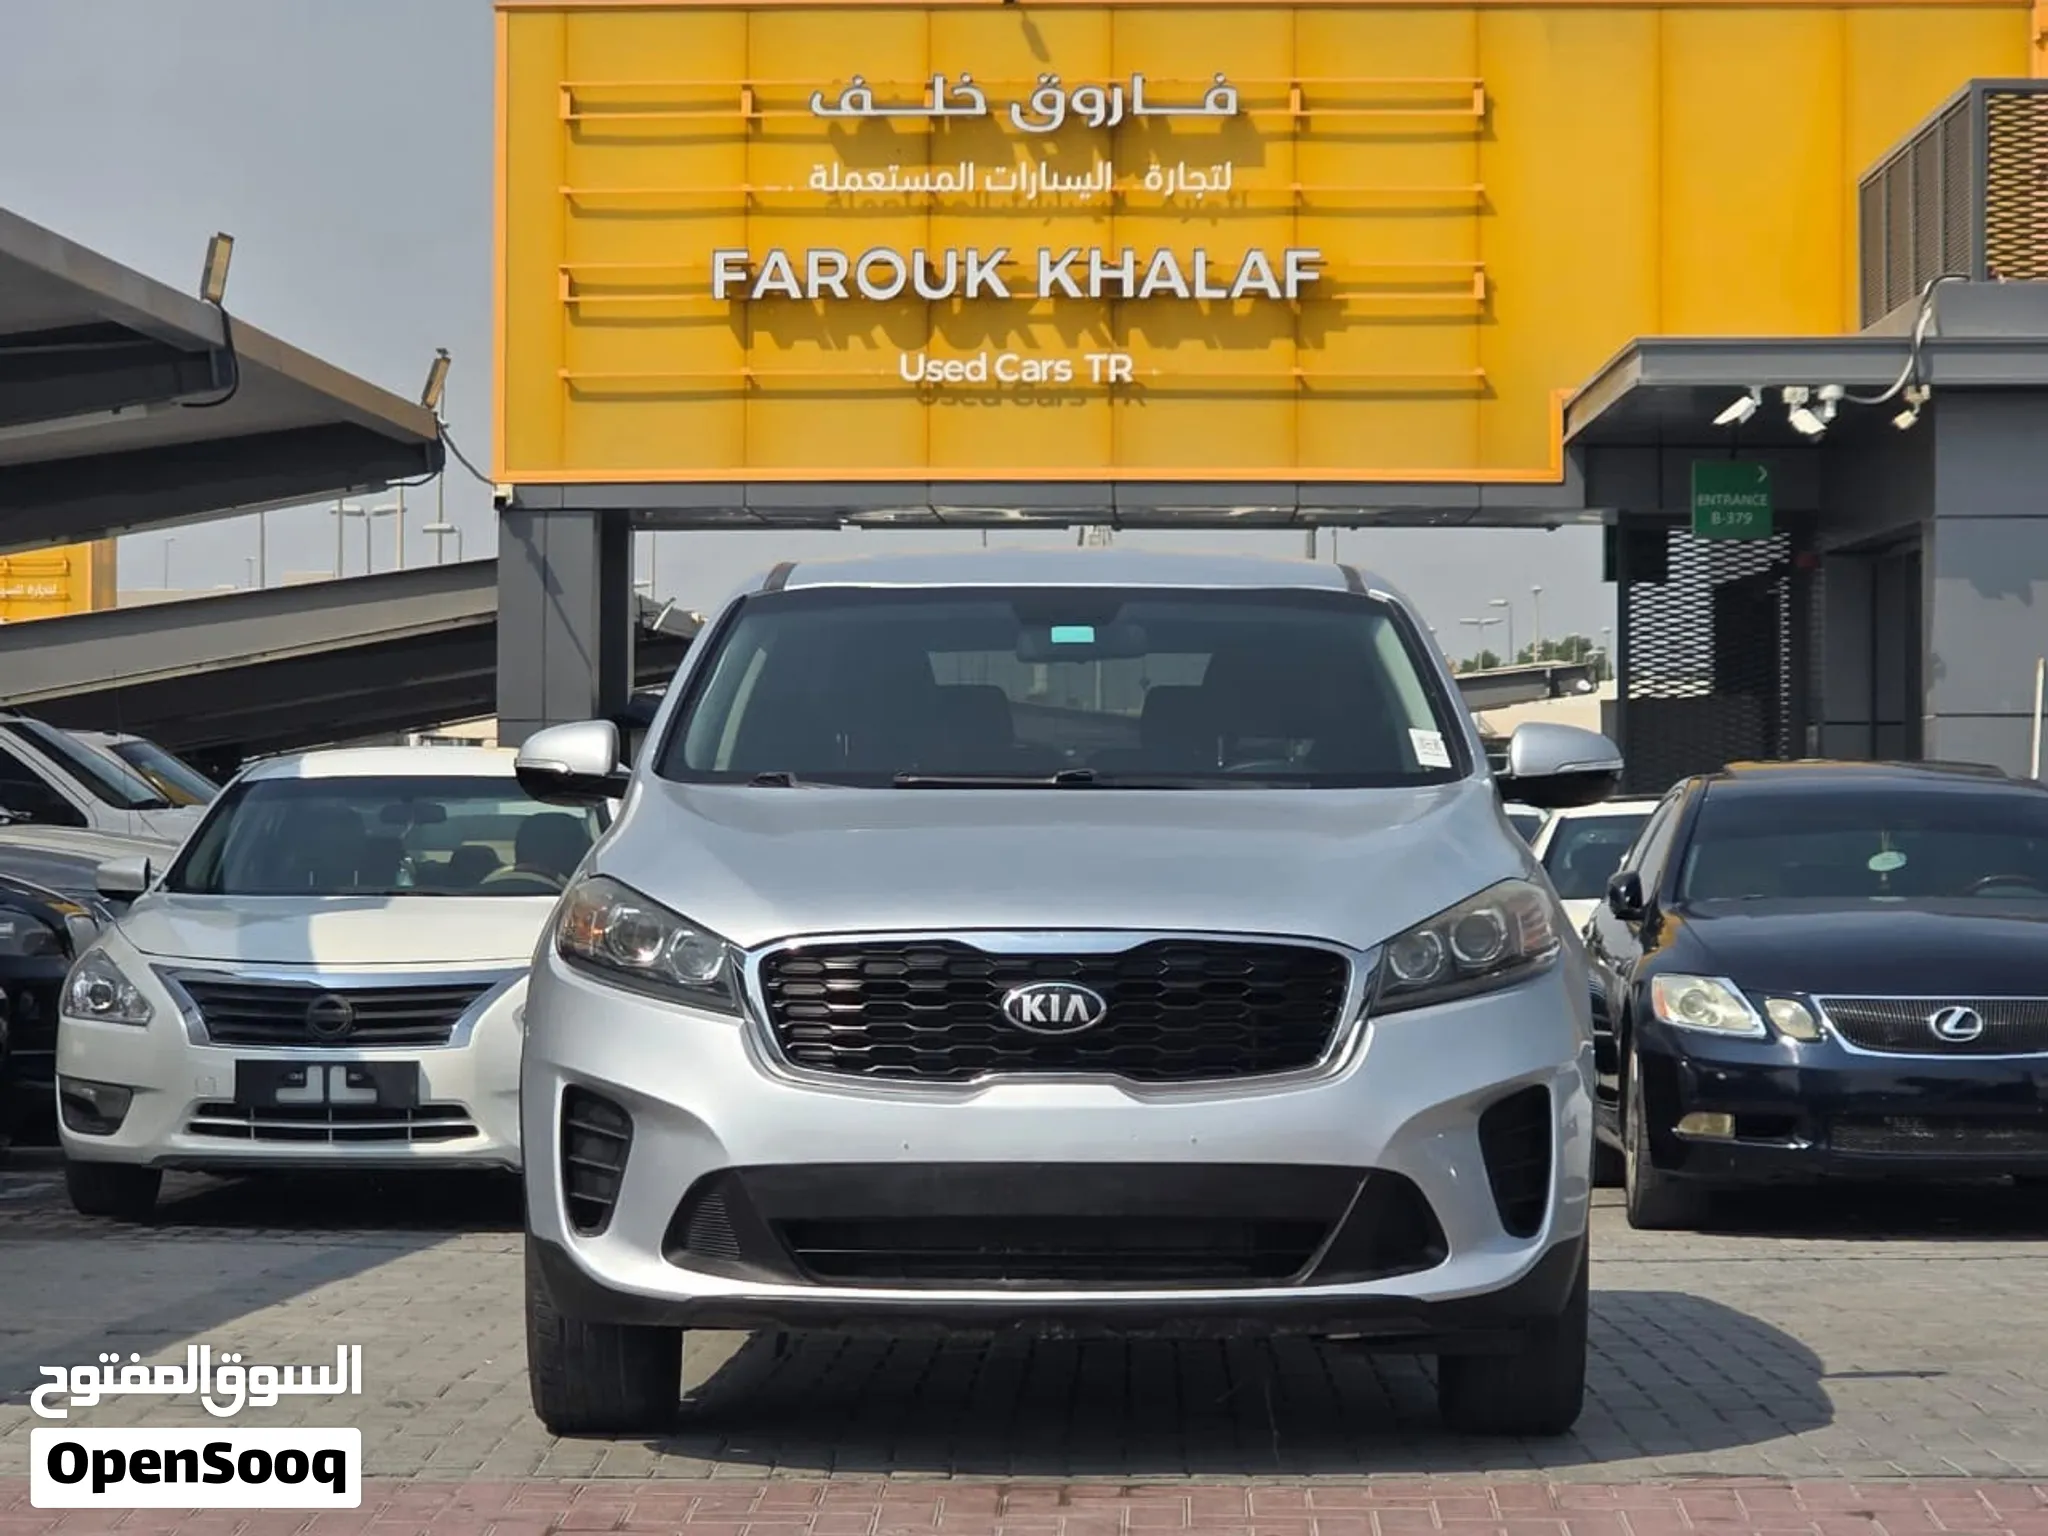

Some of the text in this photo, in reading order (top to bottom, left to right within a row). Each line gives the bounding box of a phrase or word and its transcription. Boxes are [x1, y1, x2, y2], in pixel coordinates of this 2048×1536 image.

[809, 161, 974, 192] المستعملة
[1145, 161, 1232, 198] لتجارة
[712, 248, 1322, 300] FAROUK KHALAF
[900, 351, 1133, 383] Used Cars TR
[1697, 493, 1768, 506] ENTRANCE
[1711, 510, 1753, 525] B-379
[1021, 993, 1090, 1023] KIA
